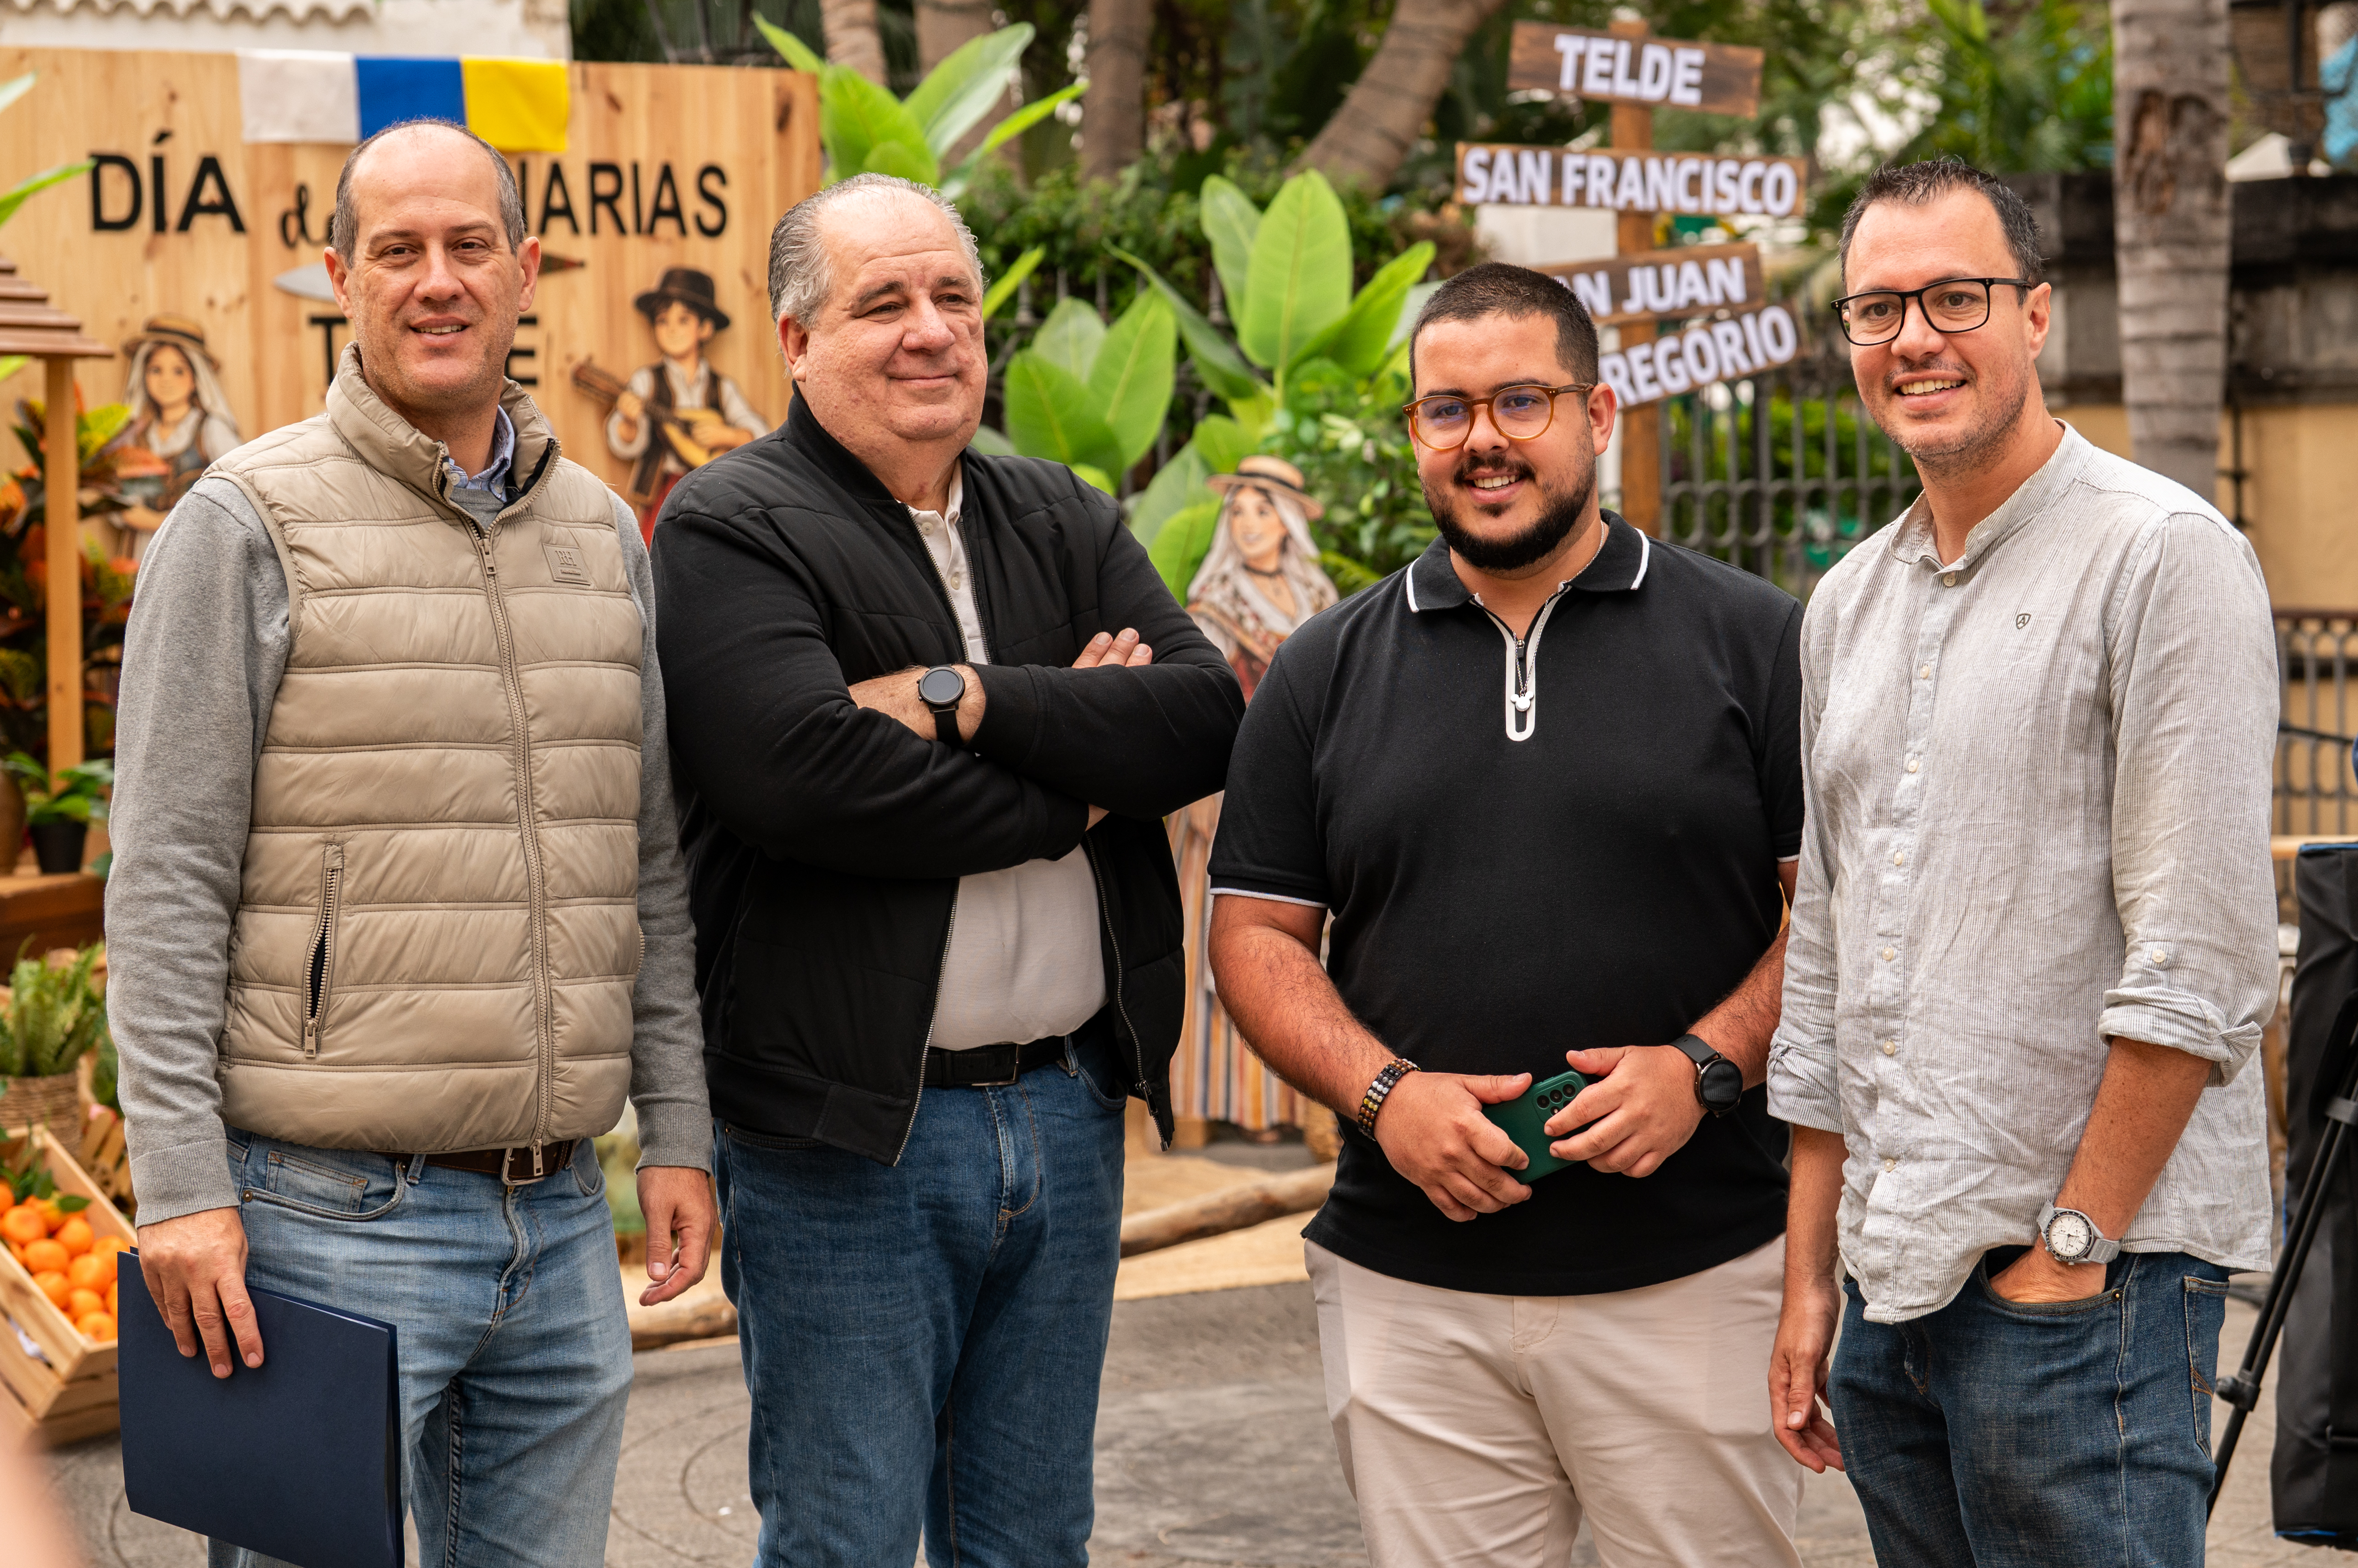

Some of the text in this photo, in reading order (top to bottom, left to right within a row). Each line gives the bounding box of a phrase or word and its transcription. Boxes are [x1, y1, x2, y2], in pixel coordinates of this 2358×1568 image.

[1554, 33, 1706, 106] TELDE
[88, 129, 246, 233] DÍA
[518, 159, 729, 238] ARIAS
[1462, 146, 1797, 217] SAN FRANCISCO
[1622, 256, 1747, 314] JUAN
[1599, 305, 1797, 410] REGORIO
